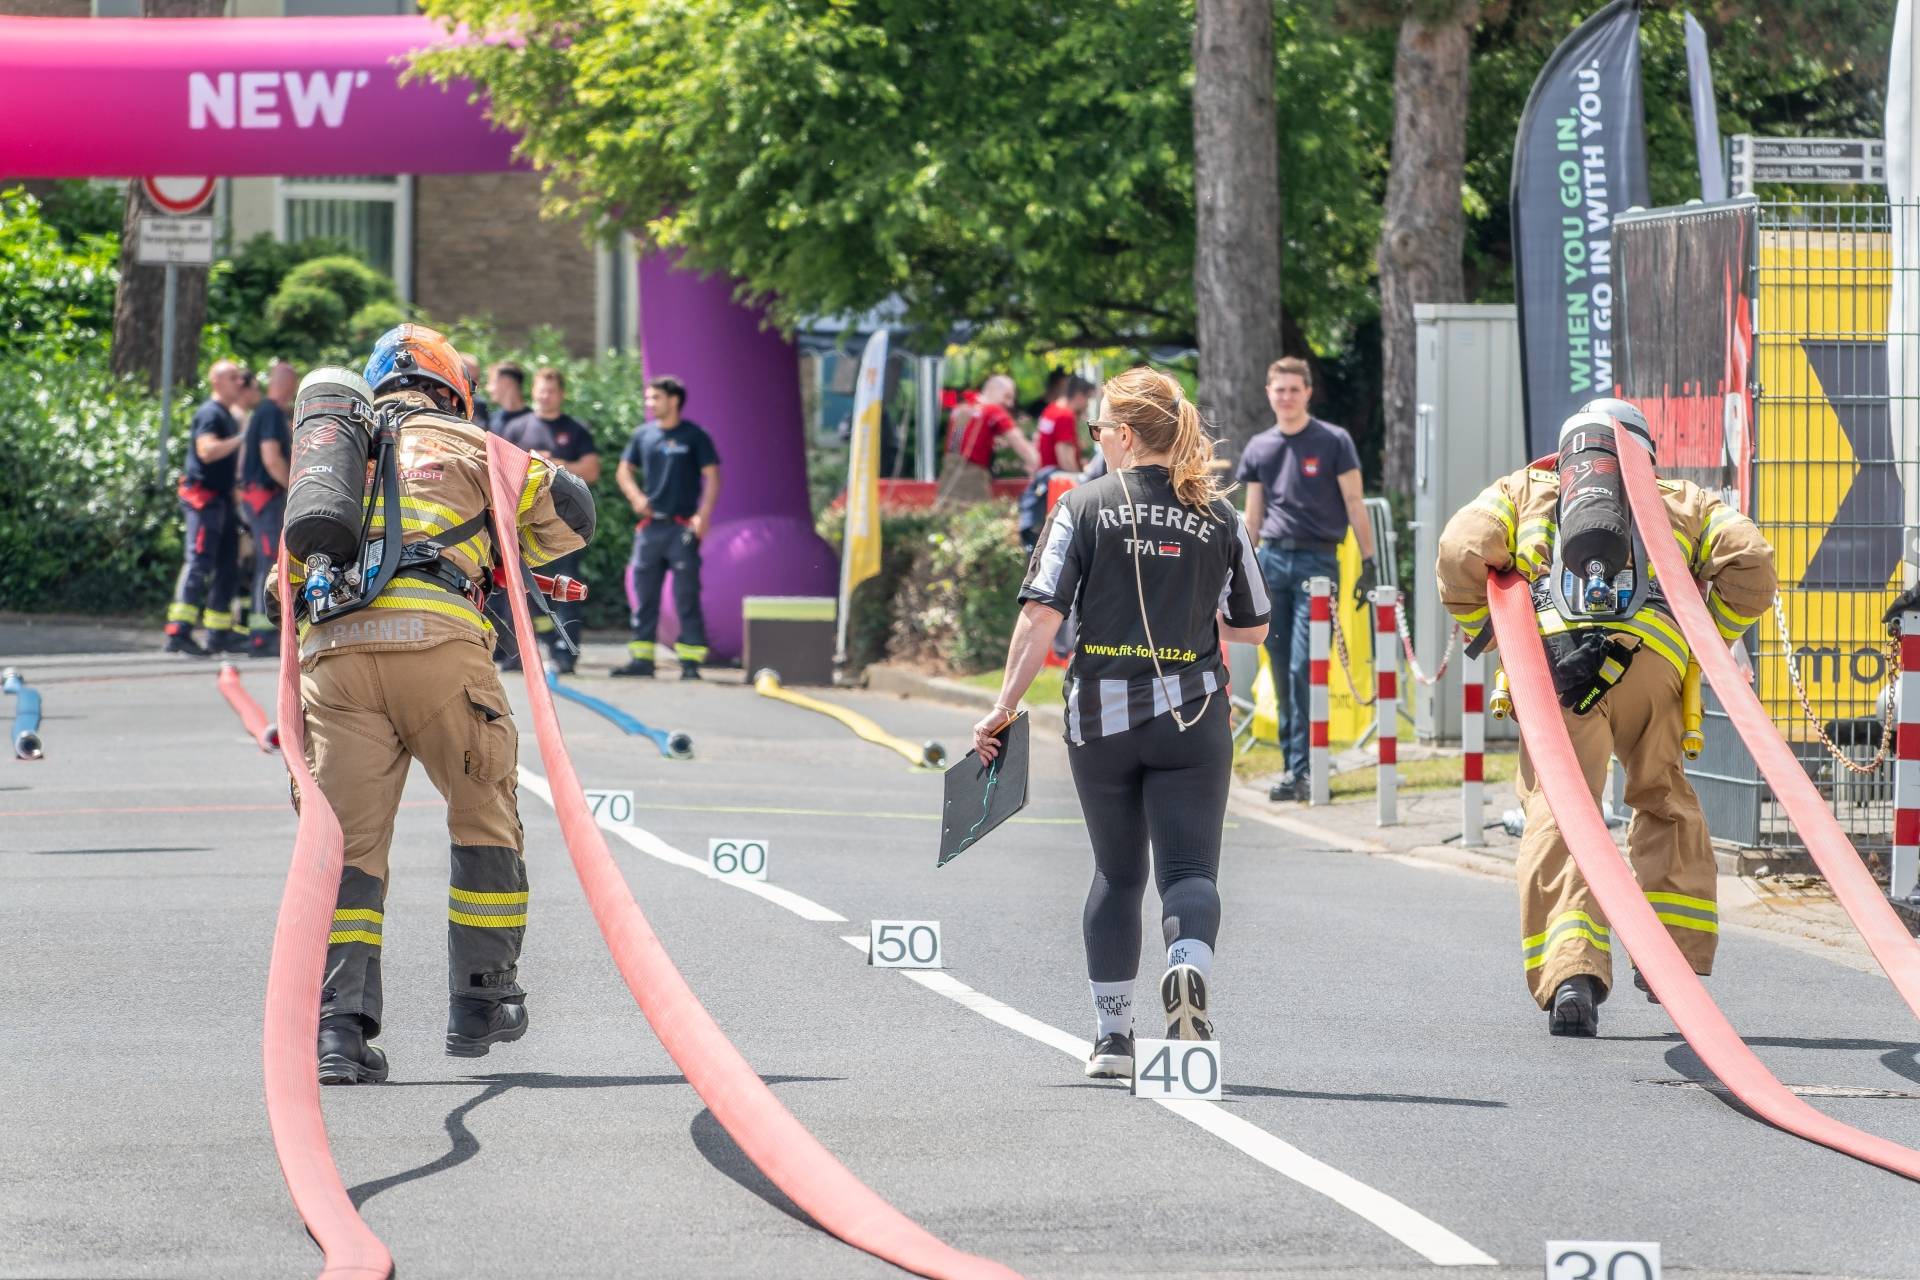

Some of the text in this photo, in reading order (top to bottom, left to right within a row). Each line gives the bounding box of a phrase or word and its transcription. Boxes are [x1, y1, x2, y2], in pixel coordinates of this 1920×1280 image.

[1578, 59, 1613, 393] WE GO IN WITH YOU.
[1556, 107, 1591, 393] WHEN YOU GO IN,
[1100, 503, 1215, 543] REFEREE
[1124, 539, 1156, 556] TFA
[1085, 643, 1197, 662] www.fit-for-112.de
[586, 794, 631, 822] 70
[712, 842, 765, 874] 60
[877, 925, 938, 963] 50
[1097, 995, 1126, 1003] DON'T
[1140, 1046, 1217, 1094] 40
